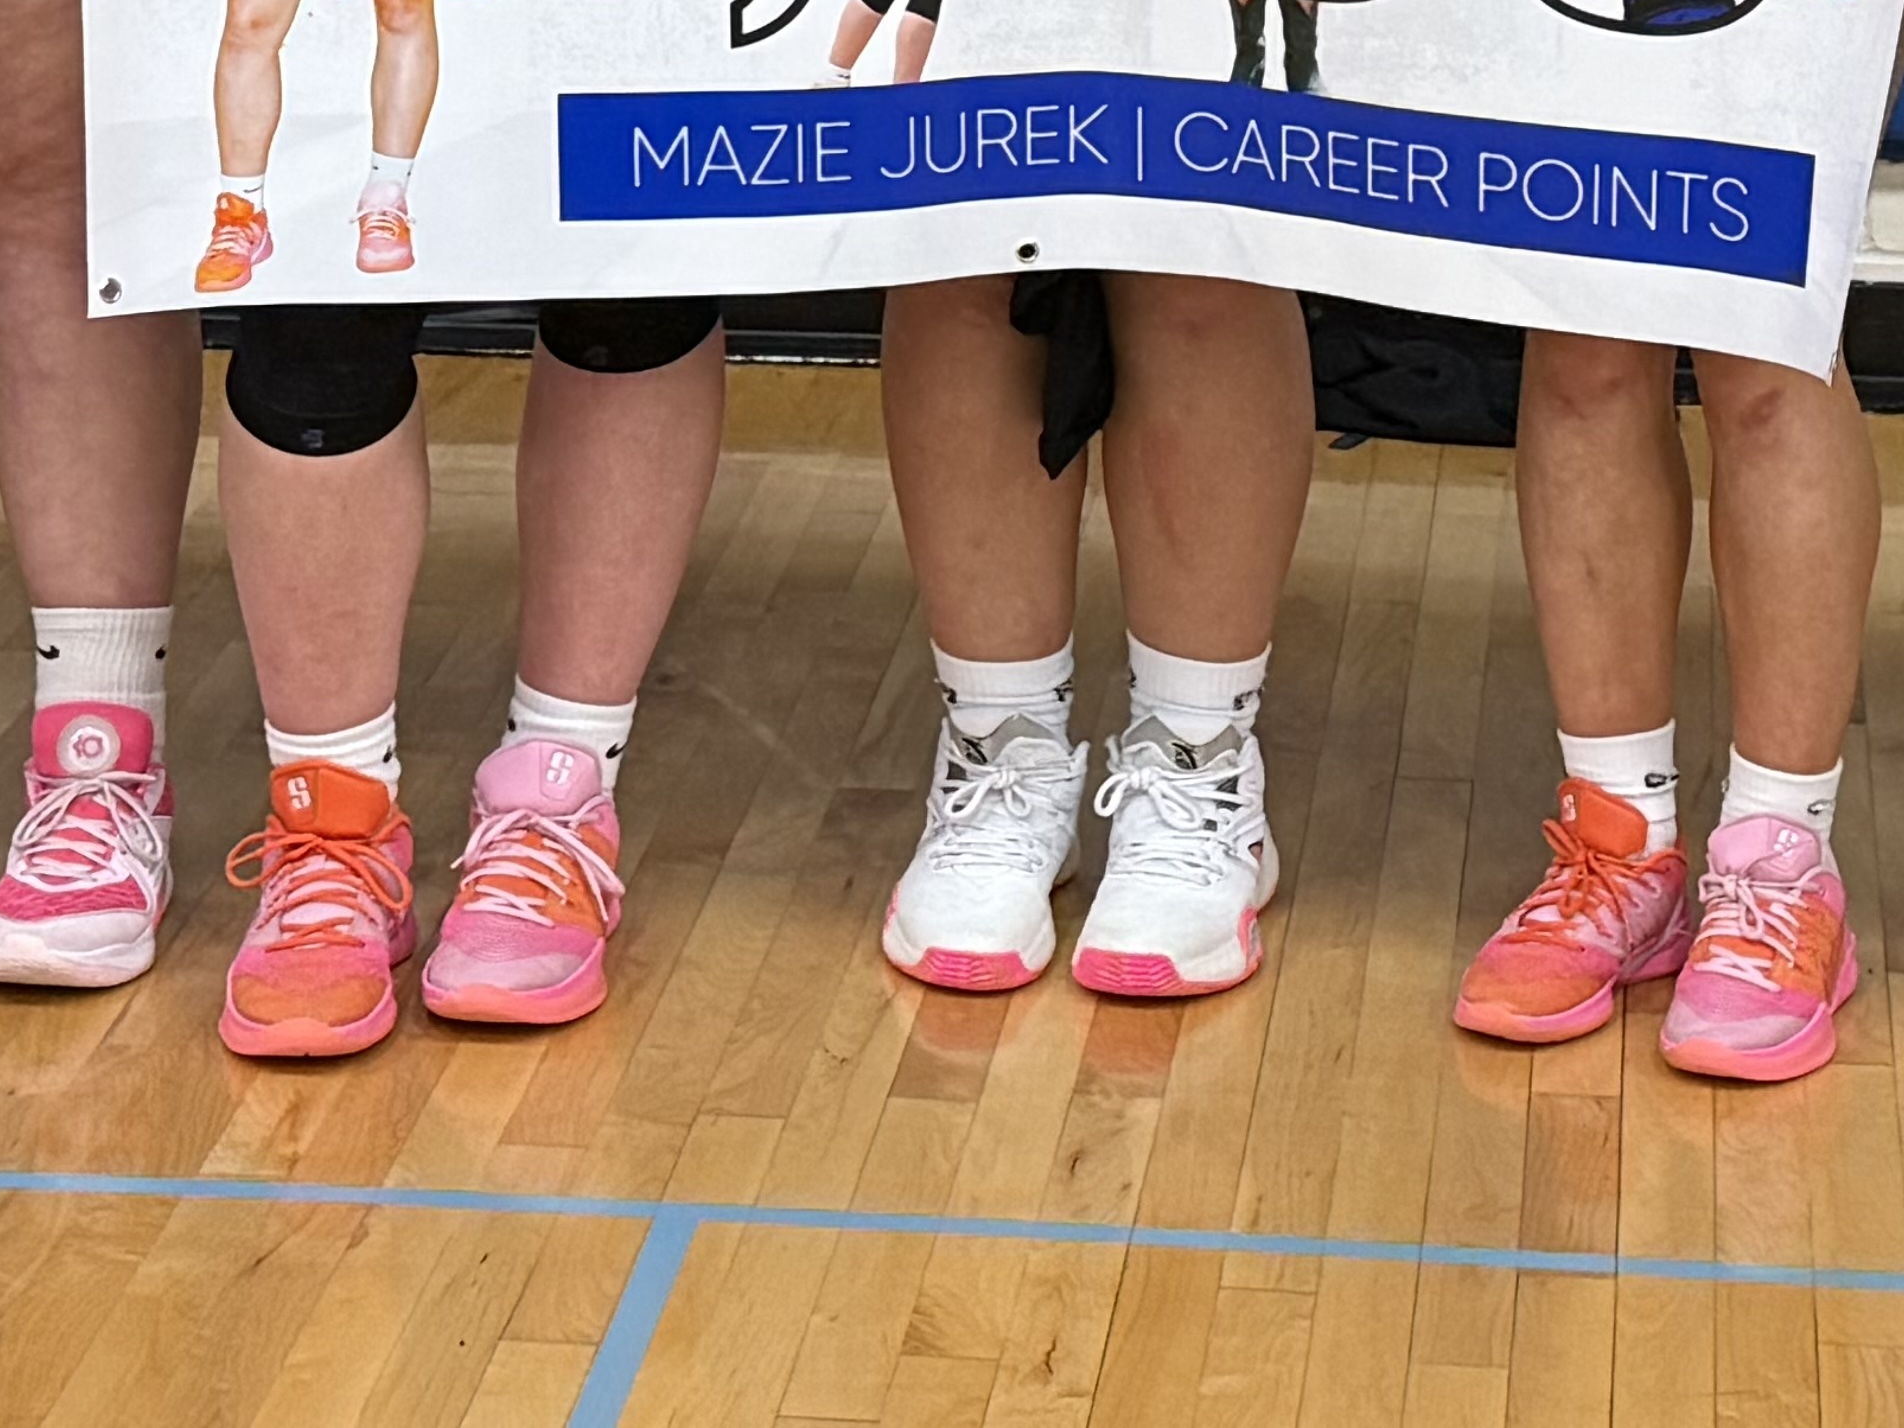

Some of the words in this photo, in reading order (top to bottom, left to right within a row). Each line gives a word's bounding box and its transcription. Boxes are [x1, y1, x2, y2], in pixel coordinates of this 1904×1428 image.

[632, 120, 853, 188] MAZIE
[880, 103, 1110, 180] JUREK
[1173, 110, 1450, 209] CAREER
[1477, 152, 1751, 242] POINTS
